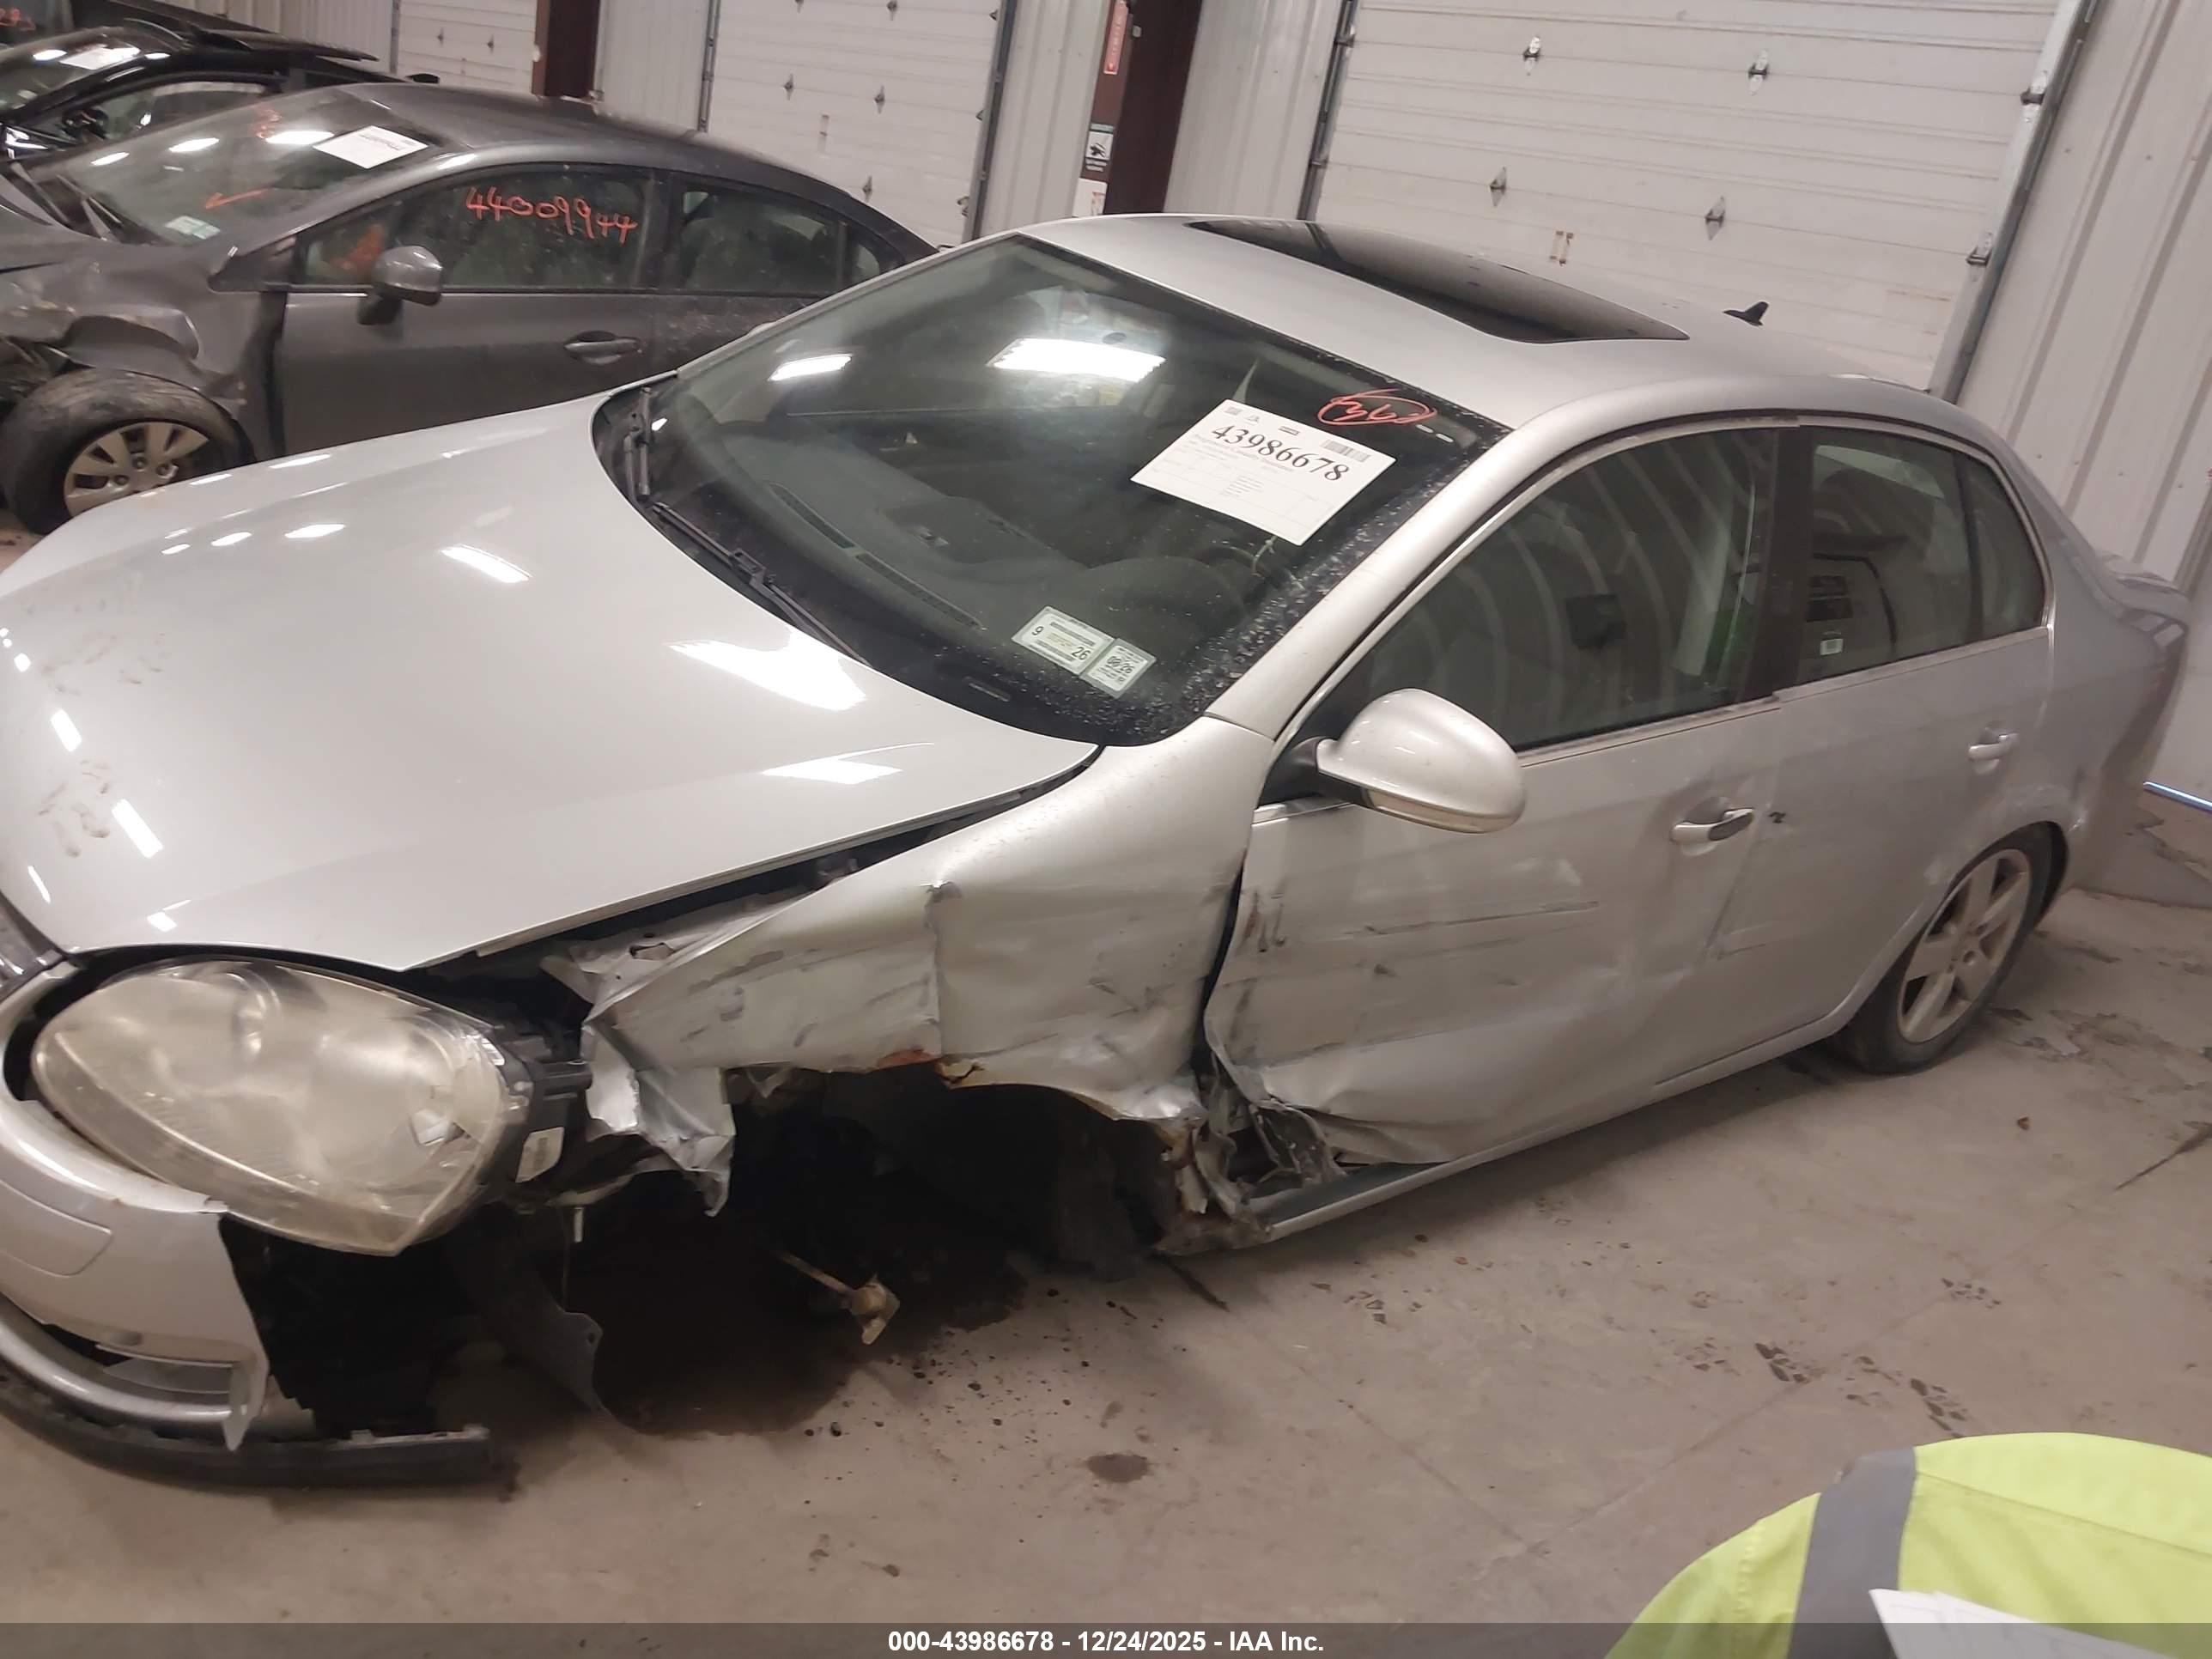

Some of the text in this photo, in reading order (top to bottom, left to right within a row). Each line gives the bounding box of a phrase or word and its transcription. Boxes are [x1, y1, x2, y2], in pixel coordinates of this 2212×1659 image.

[1210, 425, 1351, 481] 43986678
[1031, 625, 1044, 636] 9
[1072, 646, 1091, 661] 26
